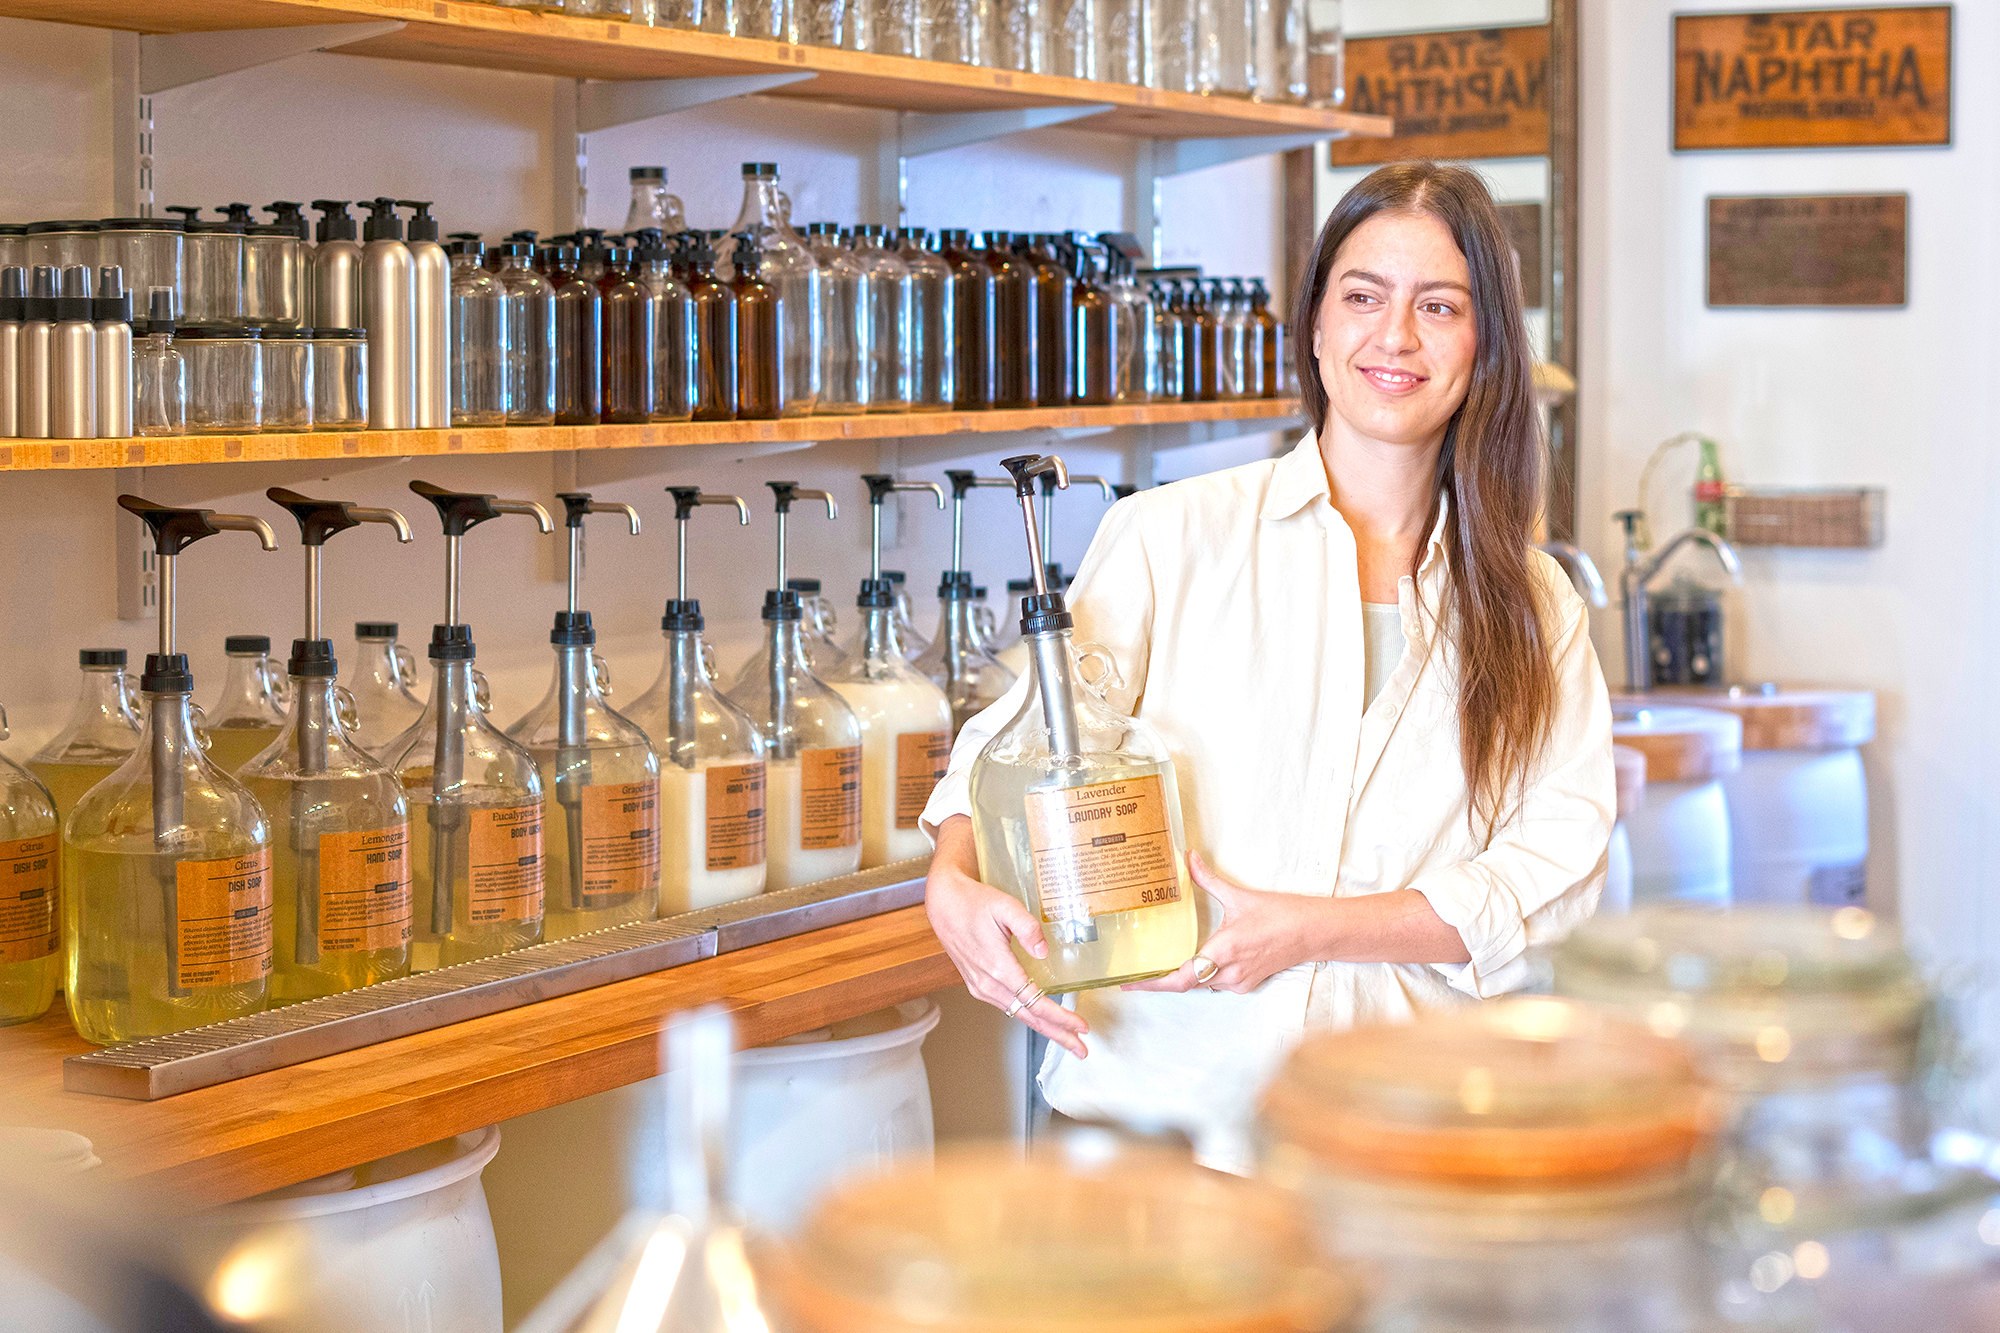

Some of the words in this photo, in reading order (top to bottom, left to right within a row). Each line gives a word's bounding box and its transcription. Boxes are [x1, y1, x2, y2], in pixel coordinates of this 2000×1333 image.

[1745, 14, 1877, 53] STAR
[1693, 44, 1929, 110] NAPHTHA
[1076, 784, 1127, 801] Lavender
[492, 810, 535, 821] Eucalyptus
[622, 801, 640, 813] BODY
[1068, 806, 1113, 824] LAUNDRY
[1116, 802, 1138, 817] SOAP
[361, 831, 406, 845] Lemongrass
[510, 826, 528, 839] BODY
[20, 841, 44, 853] Citrus
[234, 859, 258, 871] Citrus
[366, 851, 386, 865] HAND
[387, 848, 403, 861] SOAP
[13, 861, 31, 875] DISH
[33, 858, 49, 871] SOAP
[228, 879, 246, 893] DISH
[247, 875, 263, 890] SOAP
